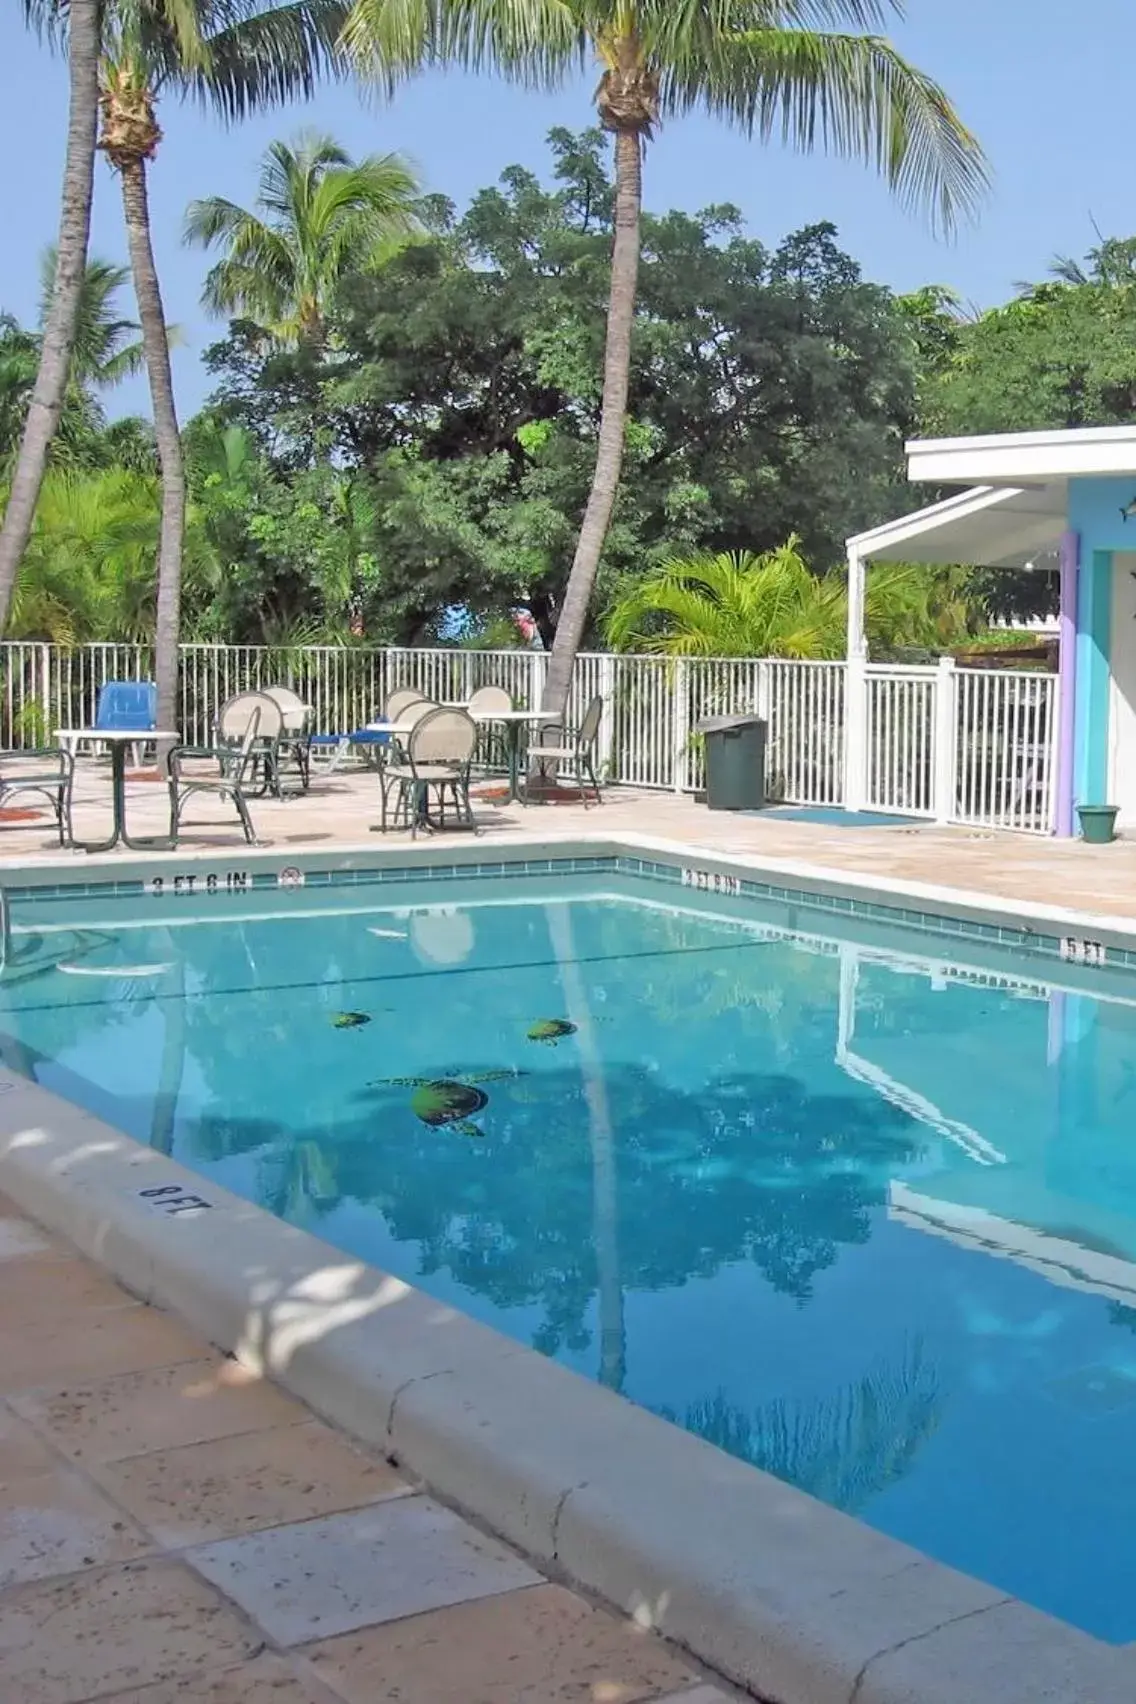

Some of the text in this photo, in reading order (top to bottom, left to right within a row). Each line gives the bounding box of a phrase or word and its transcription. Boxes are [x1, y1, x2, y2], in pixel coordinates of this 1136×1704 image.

[174, 875, 196, 889] FT
[226, 871, 246, 886] IN
[697, 871, 709, 887] FT
[1066, 937, 1101, 958] 5 FT
[139, 1186, 213, 1213] 8 FT
